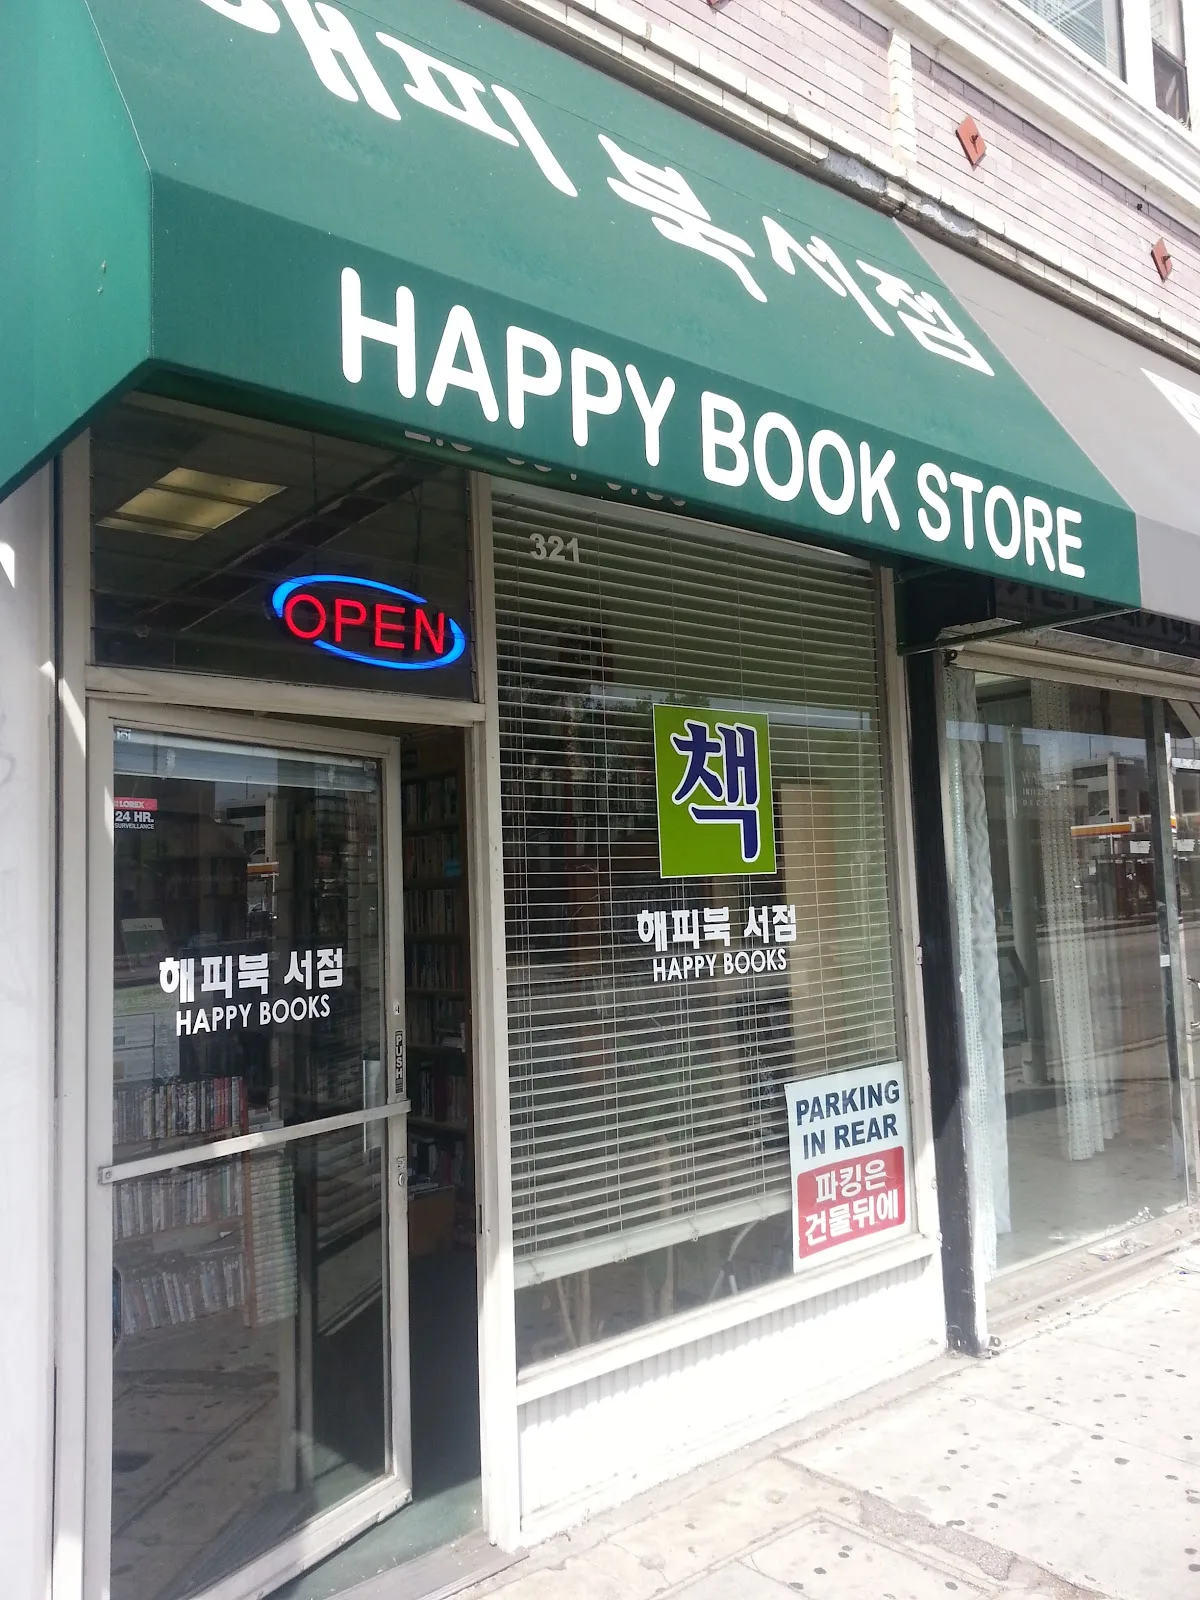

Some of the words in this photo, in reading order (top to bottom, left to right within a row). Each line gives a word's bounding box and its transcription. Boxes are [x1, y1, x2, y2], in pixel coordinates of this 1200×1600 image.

[340, 266, 676, 467] HAPPY
[700, 391, 901, 531] BOOK
[917, 462, 1086, 579] STORE
[529, 533, 581, 564] 321
[284, 594, 445, 655] OPEN
[670, 719, 761, 863] 책
[115, 811, 131, 822] 24
[134, 811, 155, 822] HR.
[636, 906, 731, 952] 해피북
[743, 904, 798, 944] 서점
[158, 952, 270, 1004] 해피북
[283, 948, 343, 990] 서점
[653, 953, 718, 982] HAPPY
[724, 948, 787, 975] BOOKS
[176, 1003, 252, 1037] HAPPY
[259, 994, 331, 1026] BOOKS
[395, 1034, 403, 1079] PUSH
[796, 1079, 900, 1126] PARKING
[803, 1129, 826, 1160] IN
[834, 1113, 899, 1151] REAR
[815, 1158, 887, 1204] 파킹은
